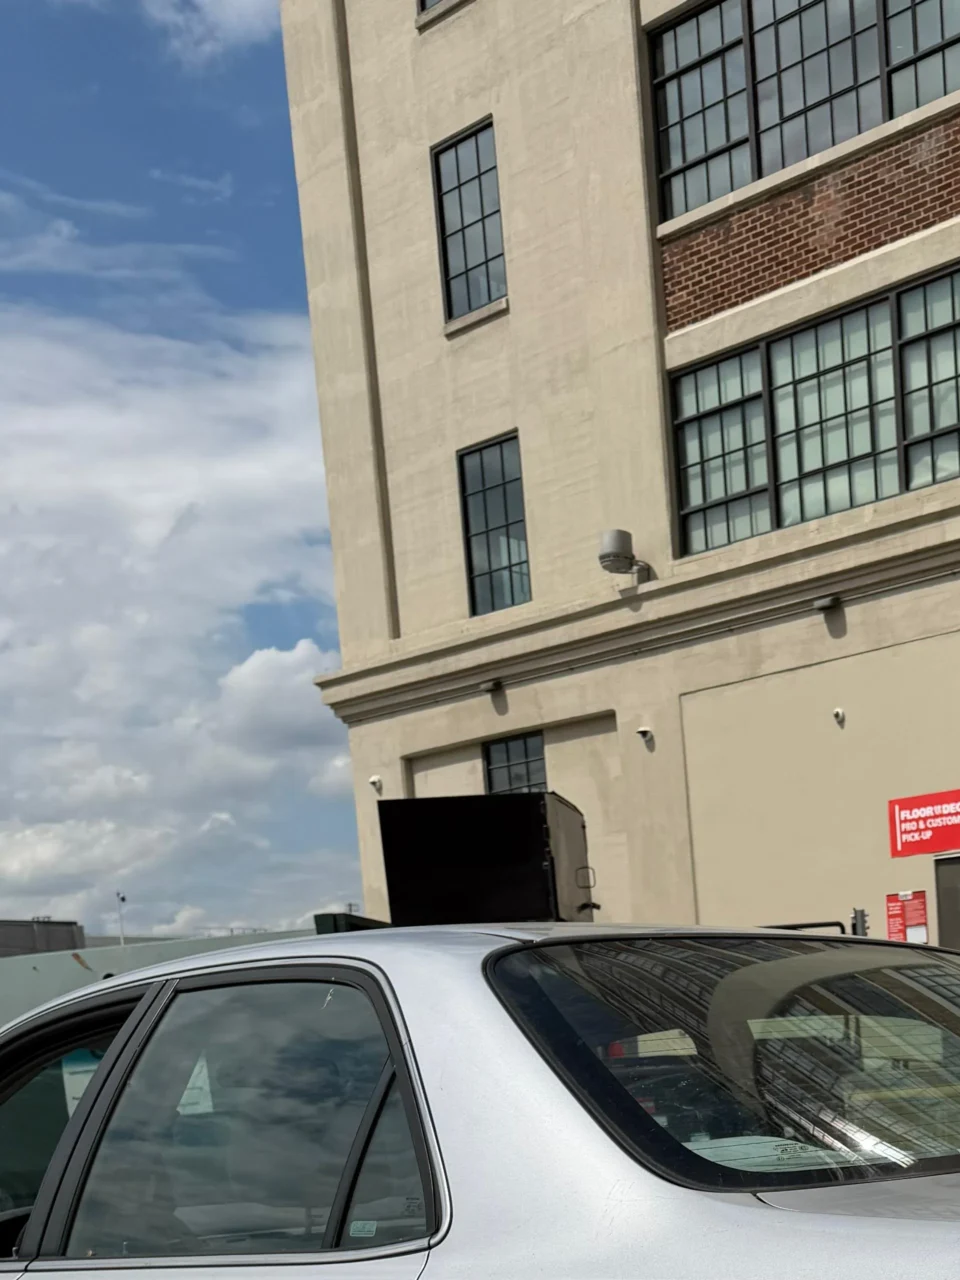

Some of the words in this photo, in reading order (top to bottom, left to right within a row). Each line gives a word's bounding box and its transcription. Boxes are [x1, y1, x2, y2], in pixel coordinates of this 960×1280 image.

[900, 807, 934, 820] FLOOR
[901, 821, 917, 832] PRO
[918, 820, 925, 829] &
[901, 830, 932, 843] PICK-UP
